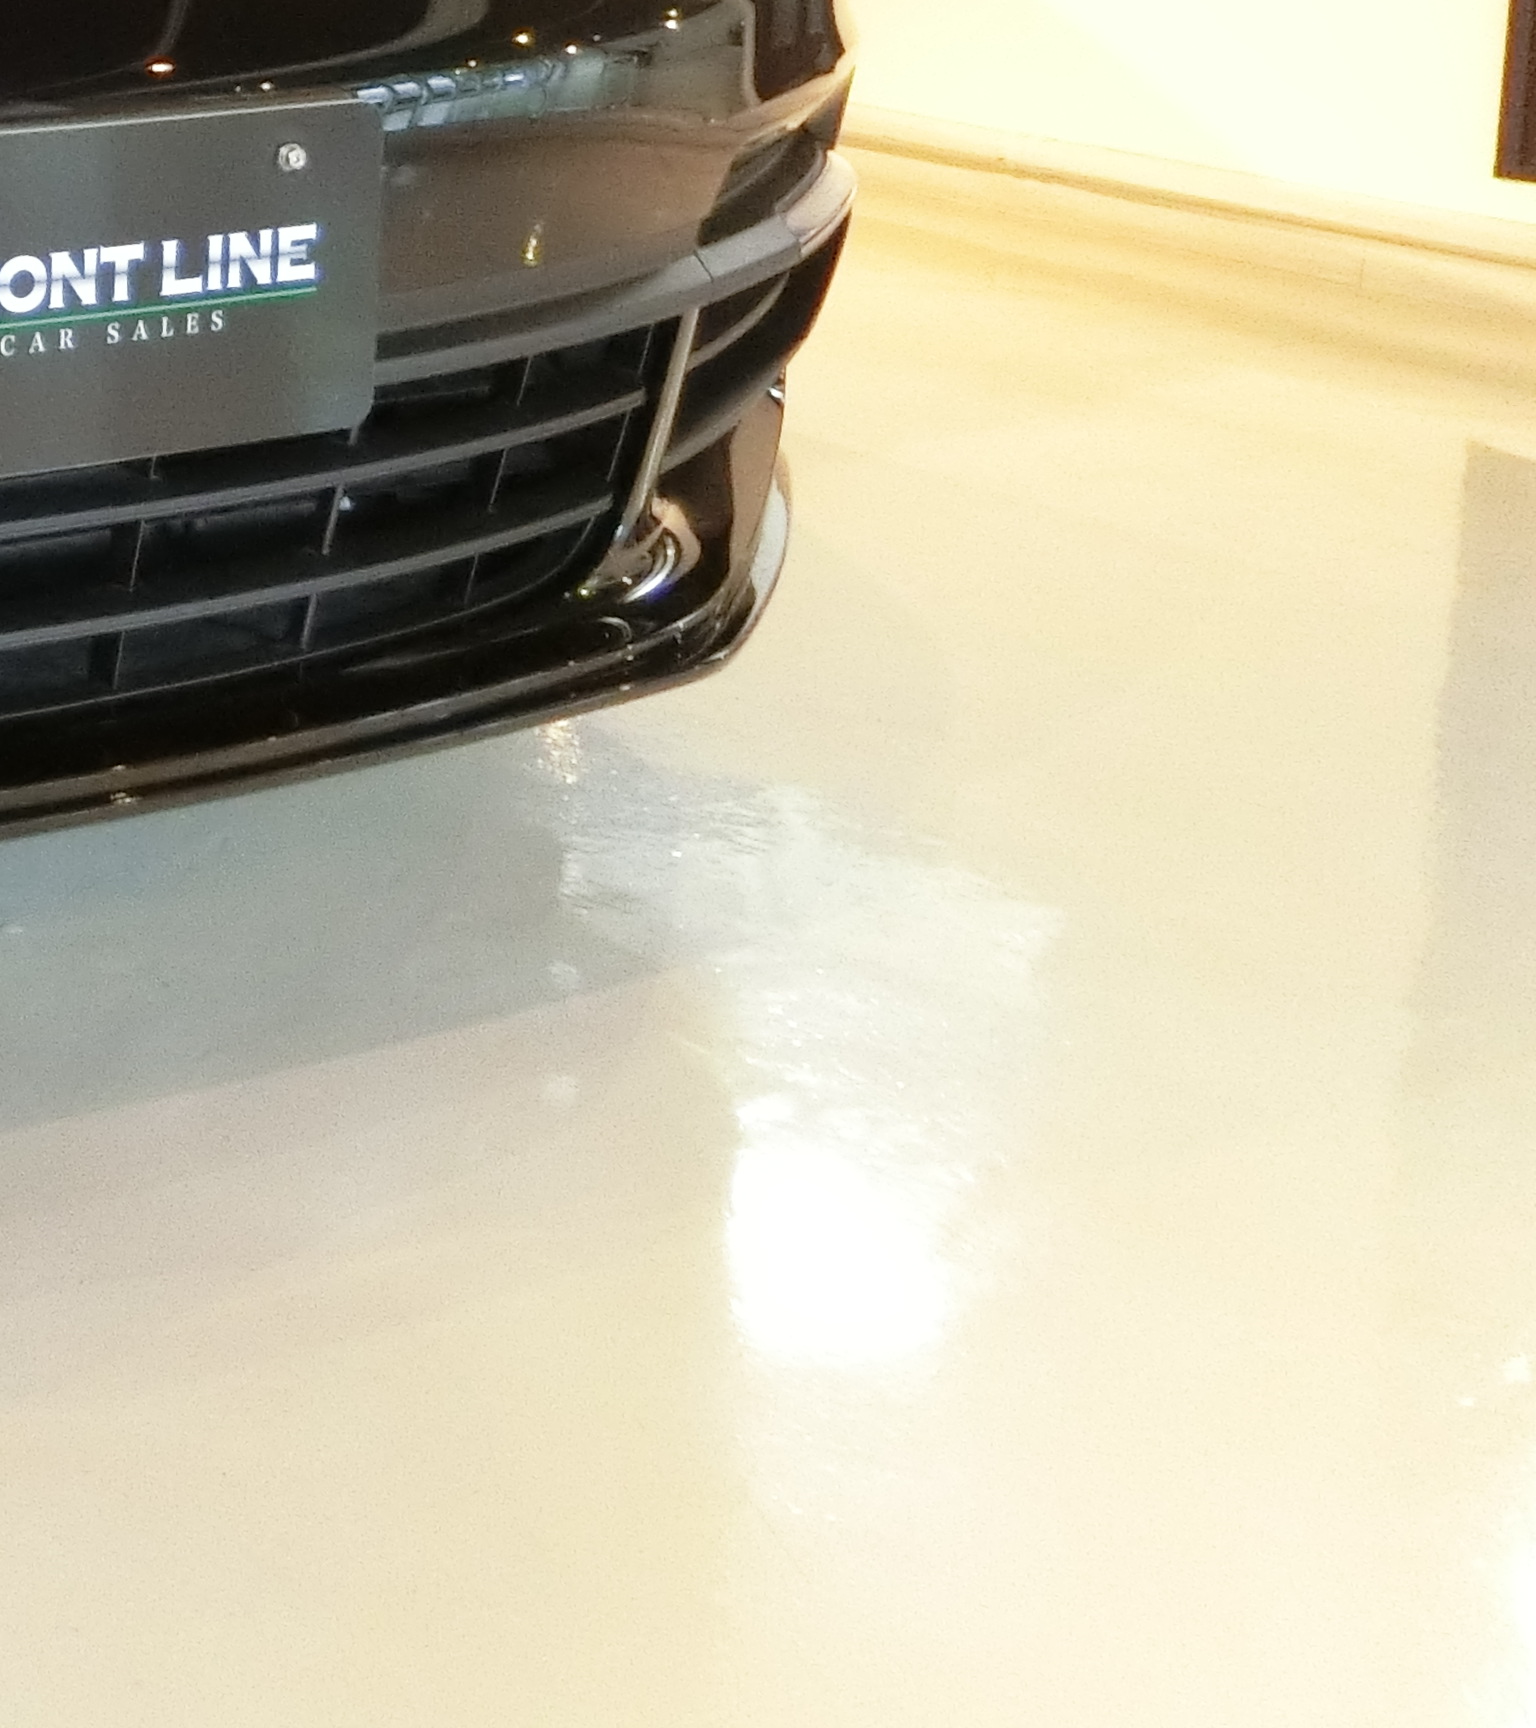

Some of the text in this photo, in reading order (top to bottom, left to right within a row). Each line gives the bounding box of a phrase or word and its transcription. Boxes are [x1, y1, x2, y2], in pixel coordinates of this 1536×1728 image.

[159, 222, 319, 298] LINE
[0, 308, 227, 357] CAR SALES
